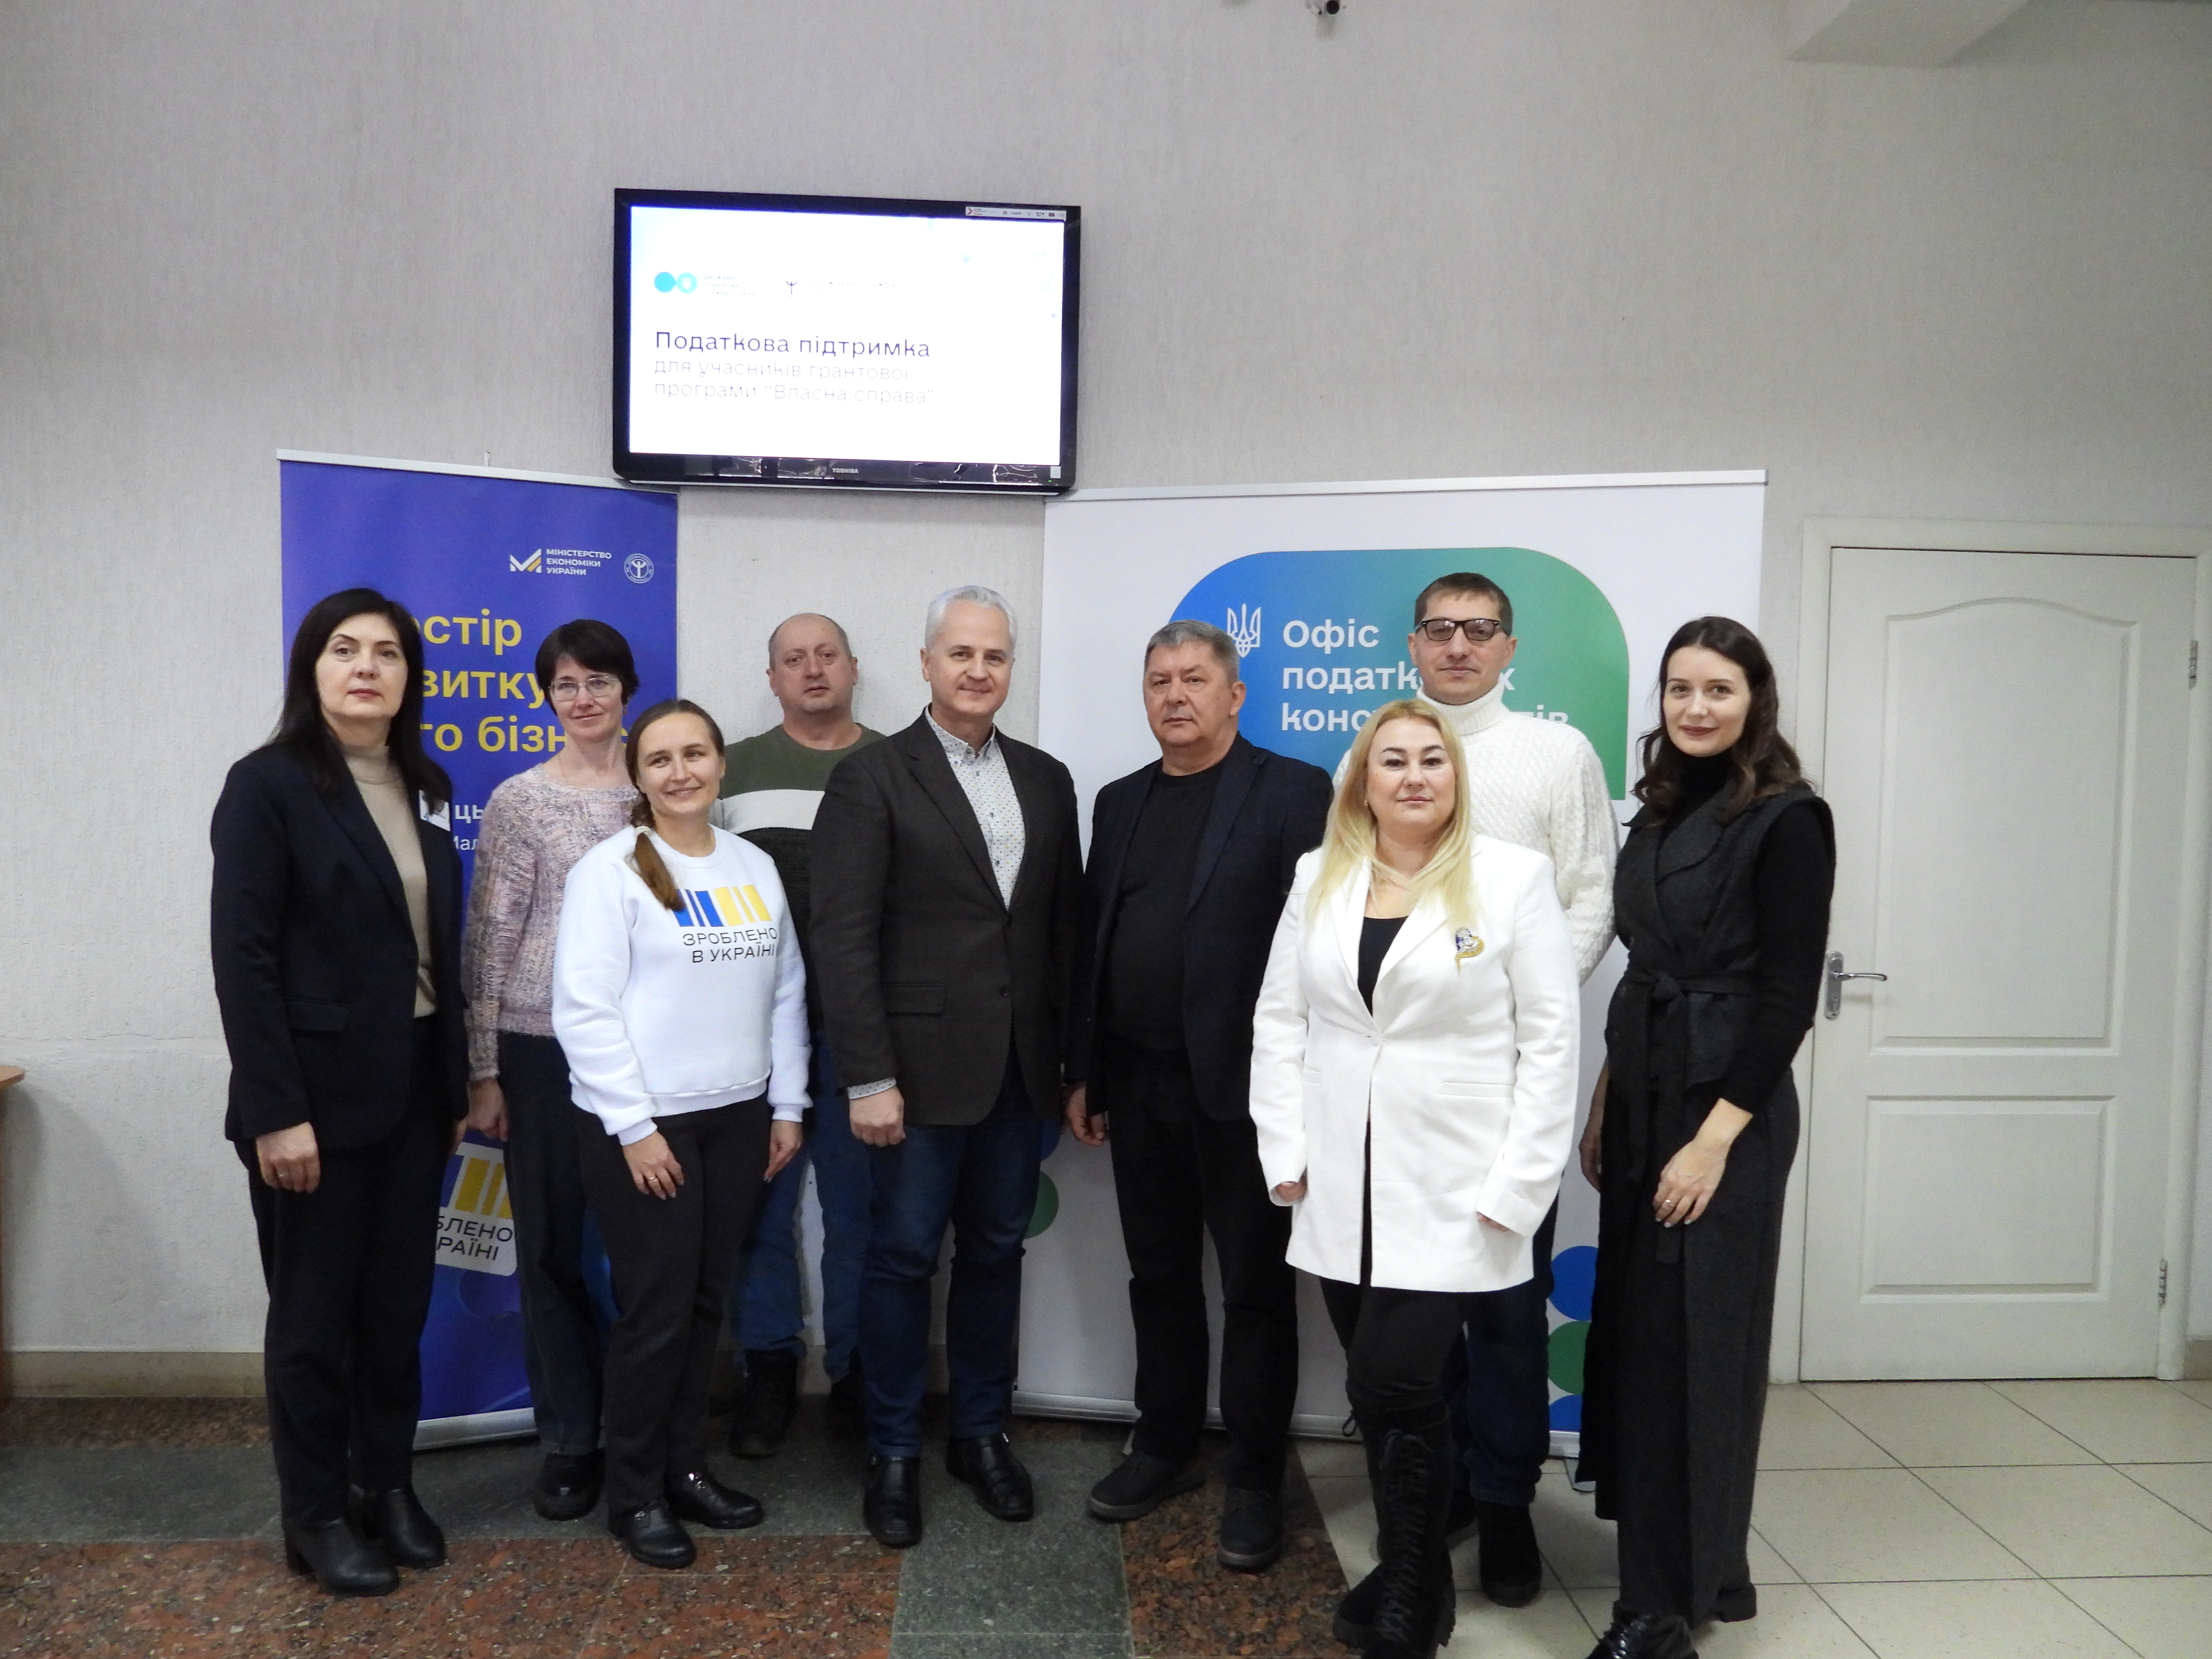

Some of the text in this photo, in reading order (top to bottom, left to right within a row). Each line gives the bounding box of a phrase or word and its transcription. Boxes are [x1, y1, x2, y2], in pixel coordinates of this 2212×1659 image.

[657, 332, 929, 359] Податкова підтримка
[655, 361, 690, 374] для
[656, 384, 756, 399] програми
[546, 549, 612, 559] МІНІСТЕРСТВО
[546, 558, 601, 567] ЕКОНОМІКИ
[546, 567, 587, 576] УКРАЇНИ
[416, 608, 522, 656] стір
[1283, 618, 1379, 654] Офіс
[683, 927, 778, 946] ЗРОБЛЕНО
[693, 942, 775, 962] В УКРАЇНІ
[437, 1215, 513, 1242] БЛЕНО
[437, 1236, 499, 1261] РАЇНІ
